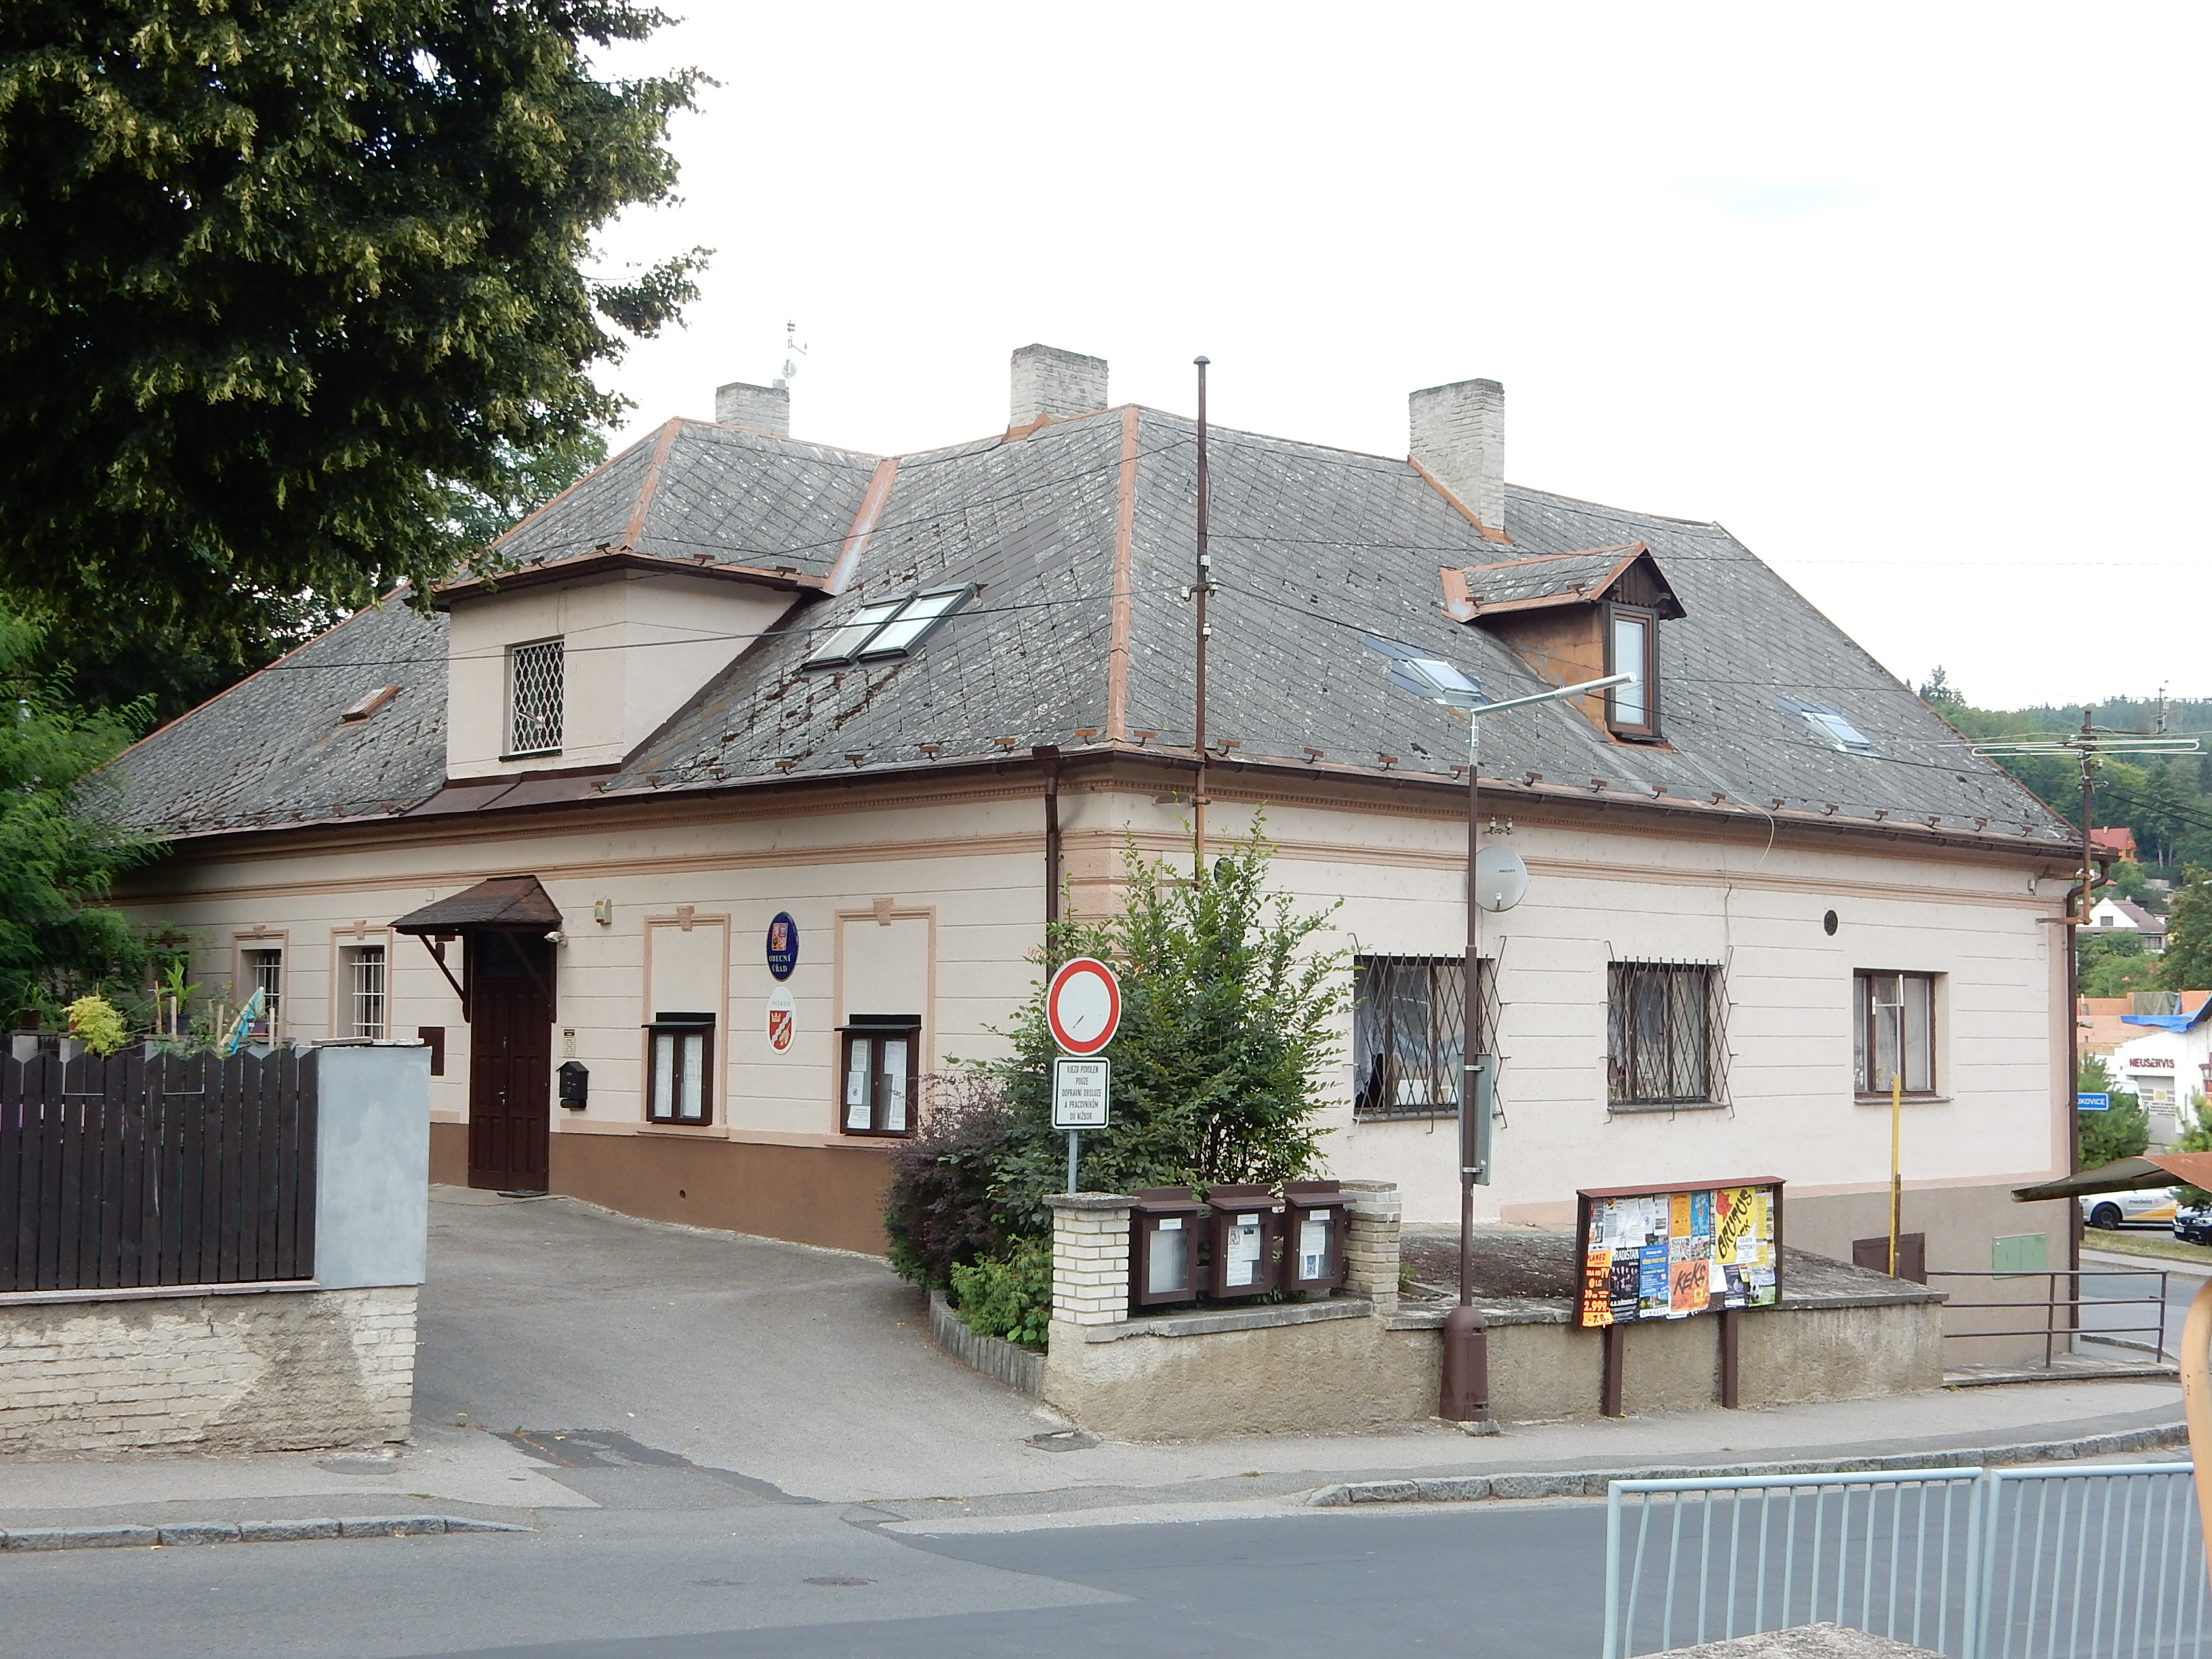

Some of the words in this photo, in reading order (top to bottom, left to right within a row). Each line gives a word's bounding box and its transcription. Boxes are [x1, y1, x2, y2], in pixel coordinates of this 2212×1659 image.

[769, 953, 791, 962] OBECNÍ
[772, 964, 787, 972] ÚŘAD
[1067, 1065, 1079, 1073] VJEZD
[1080, 1065, 1099, 1073] POVOLEN
[1062, 1087, 1082, 1097] DOPRAVNÍ
[1717, 1189, 1753, 1259] BRUTUS
[1601, 1268, 1610, 1278] TV
[1674, 1263, 1706, 1296] KEKS
